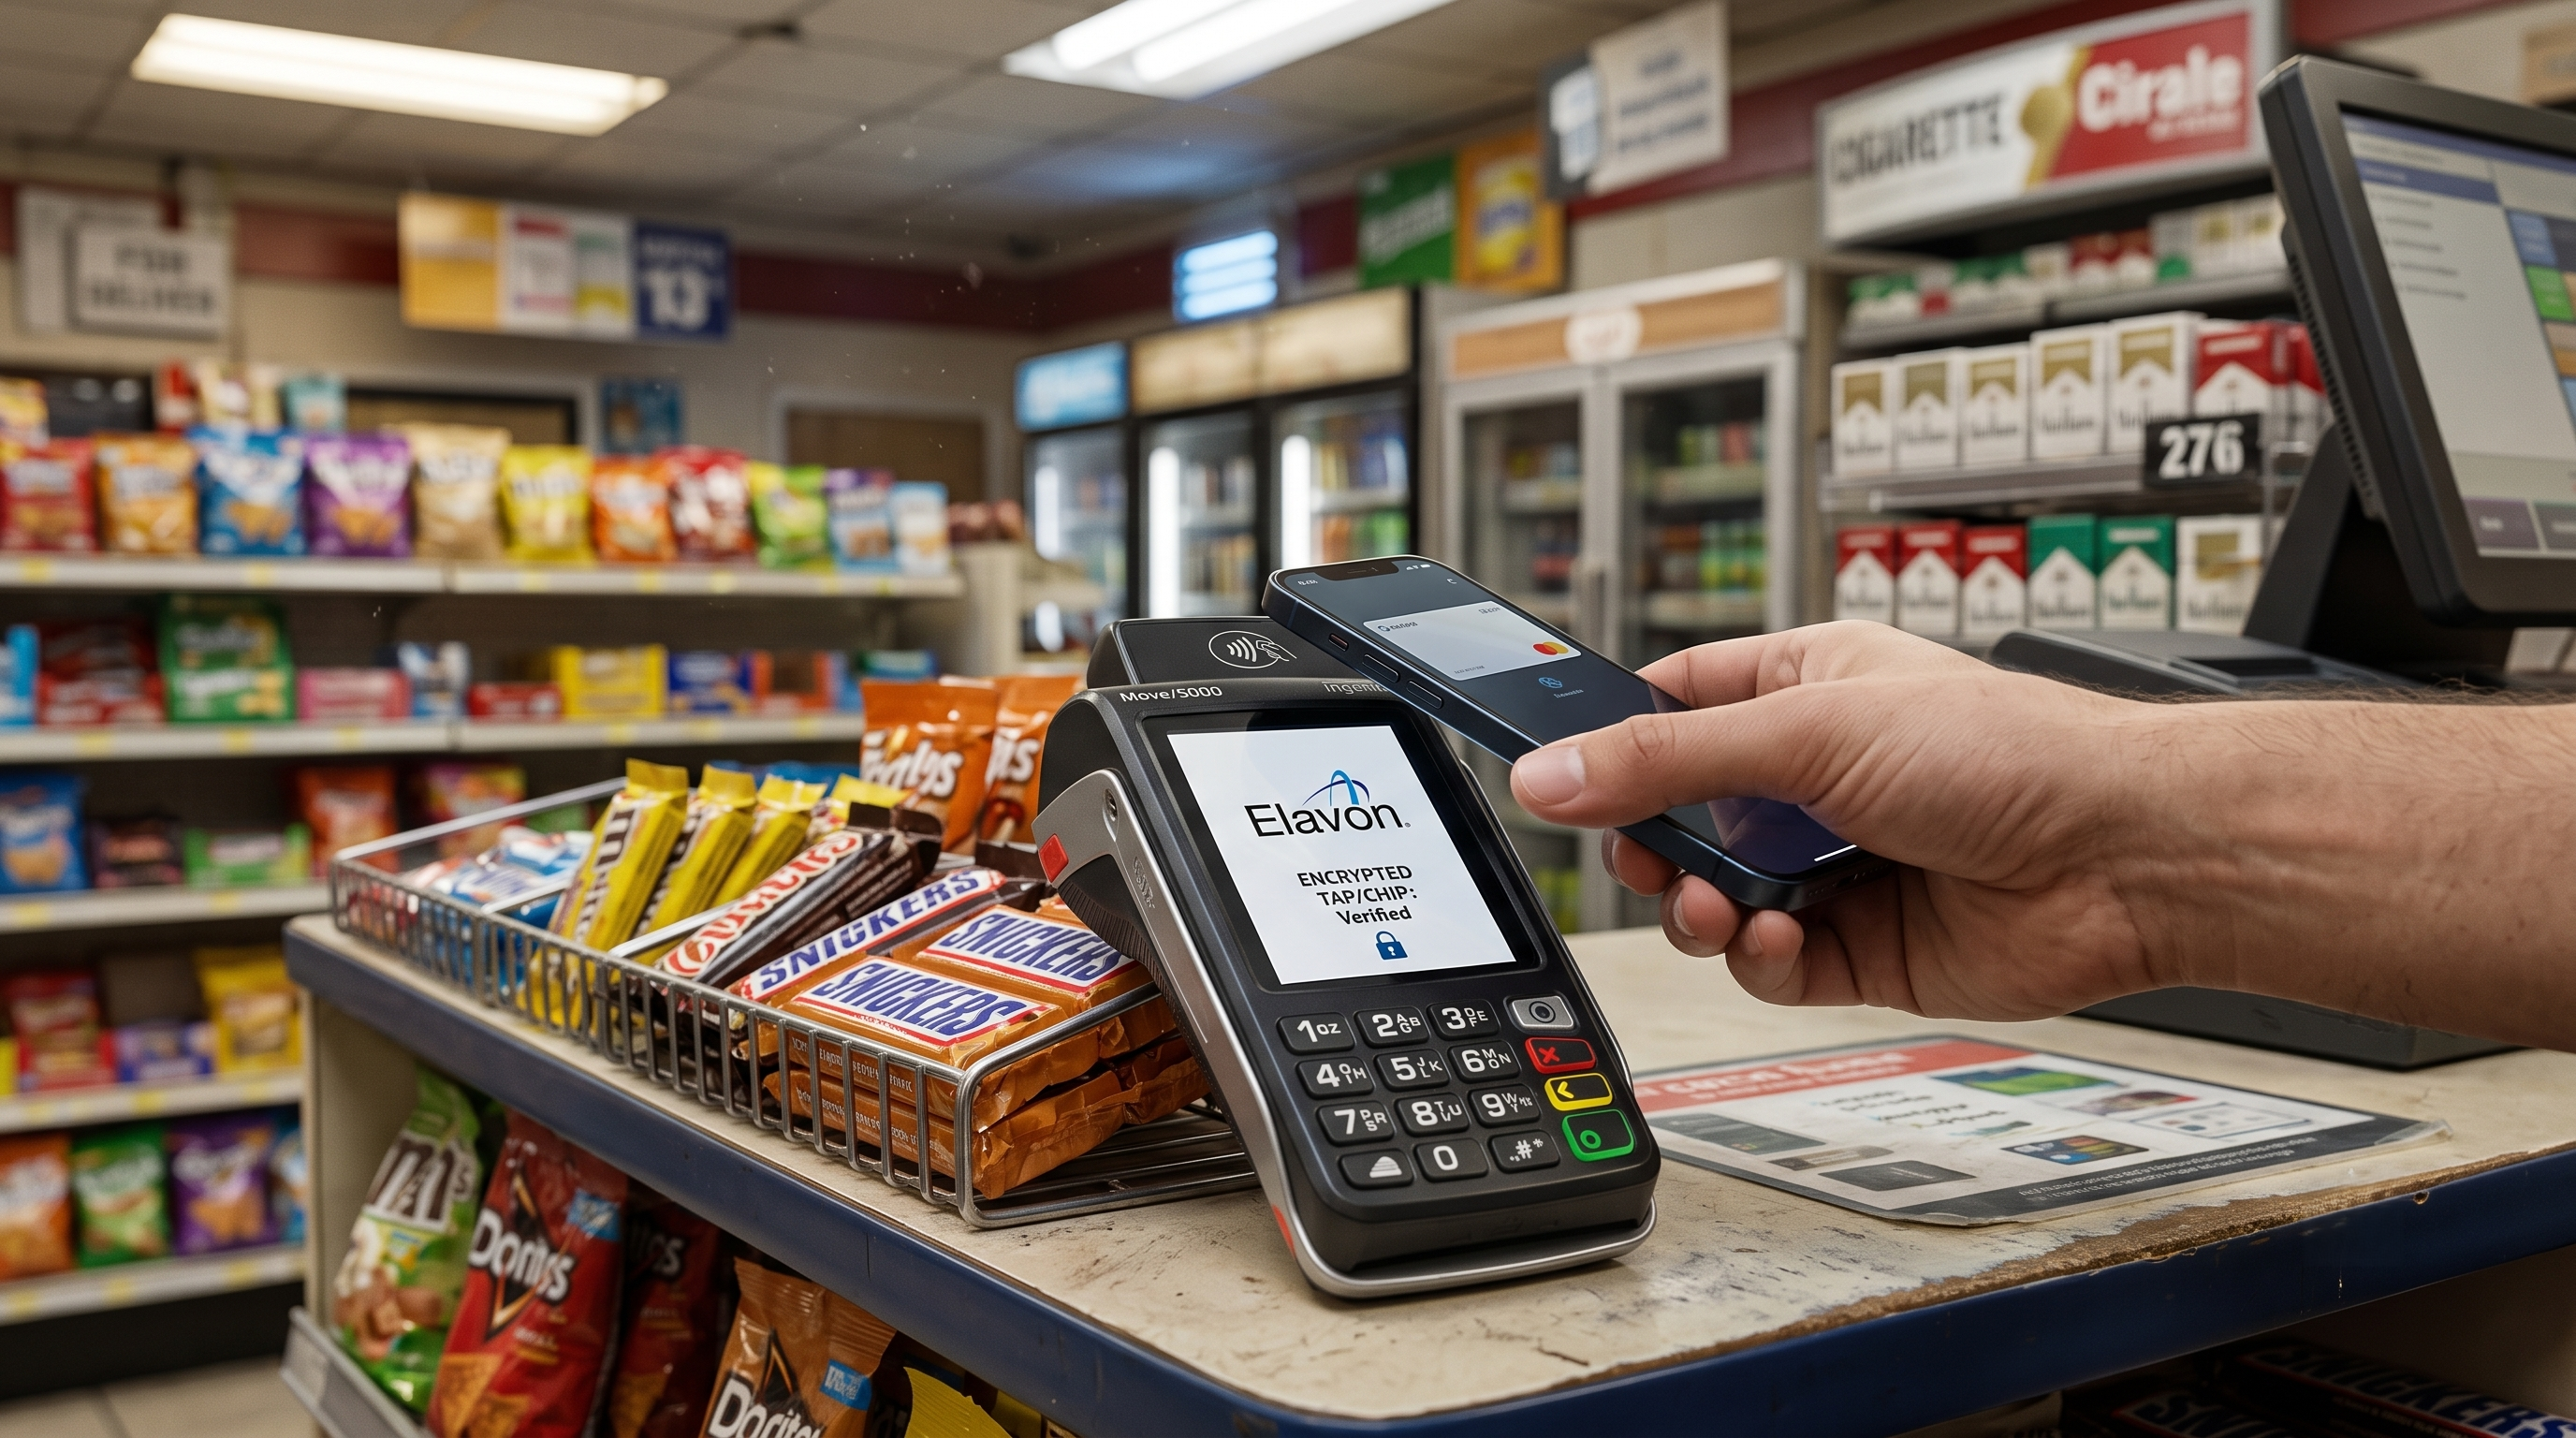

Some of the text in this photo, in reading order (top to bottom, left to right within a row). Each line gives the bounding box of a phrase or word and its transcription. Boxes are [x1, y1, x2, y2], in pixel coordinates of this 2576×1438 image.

[2158, 420, 2245, 480] 276
[1120, 686, 1222, 702] Move/5000
[1244, 803, 1404, 837] Elavon
[1297, 865, 1412, 887] ENCRYPTED
[1316, 886, 1417, 906] TAP/CHIP:
[1336, 905, 1412, 924] Verified
[760, 871, 980, 990] SNICKERS
[938, 912, 1126, 983] SNICKERS
[812, 962, 1027, 1036] SNICKERS
[1432, 1145, 1459, 1170] 0
